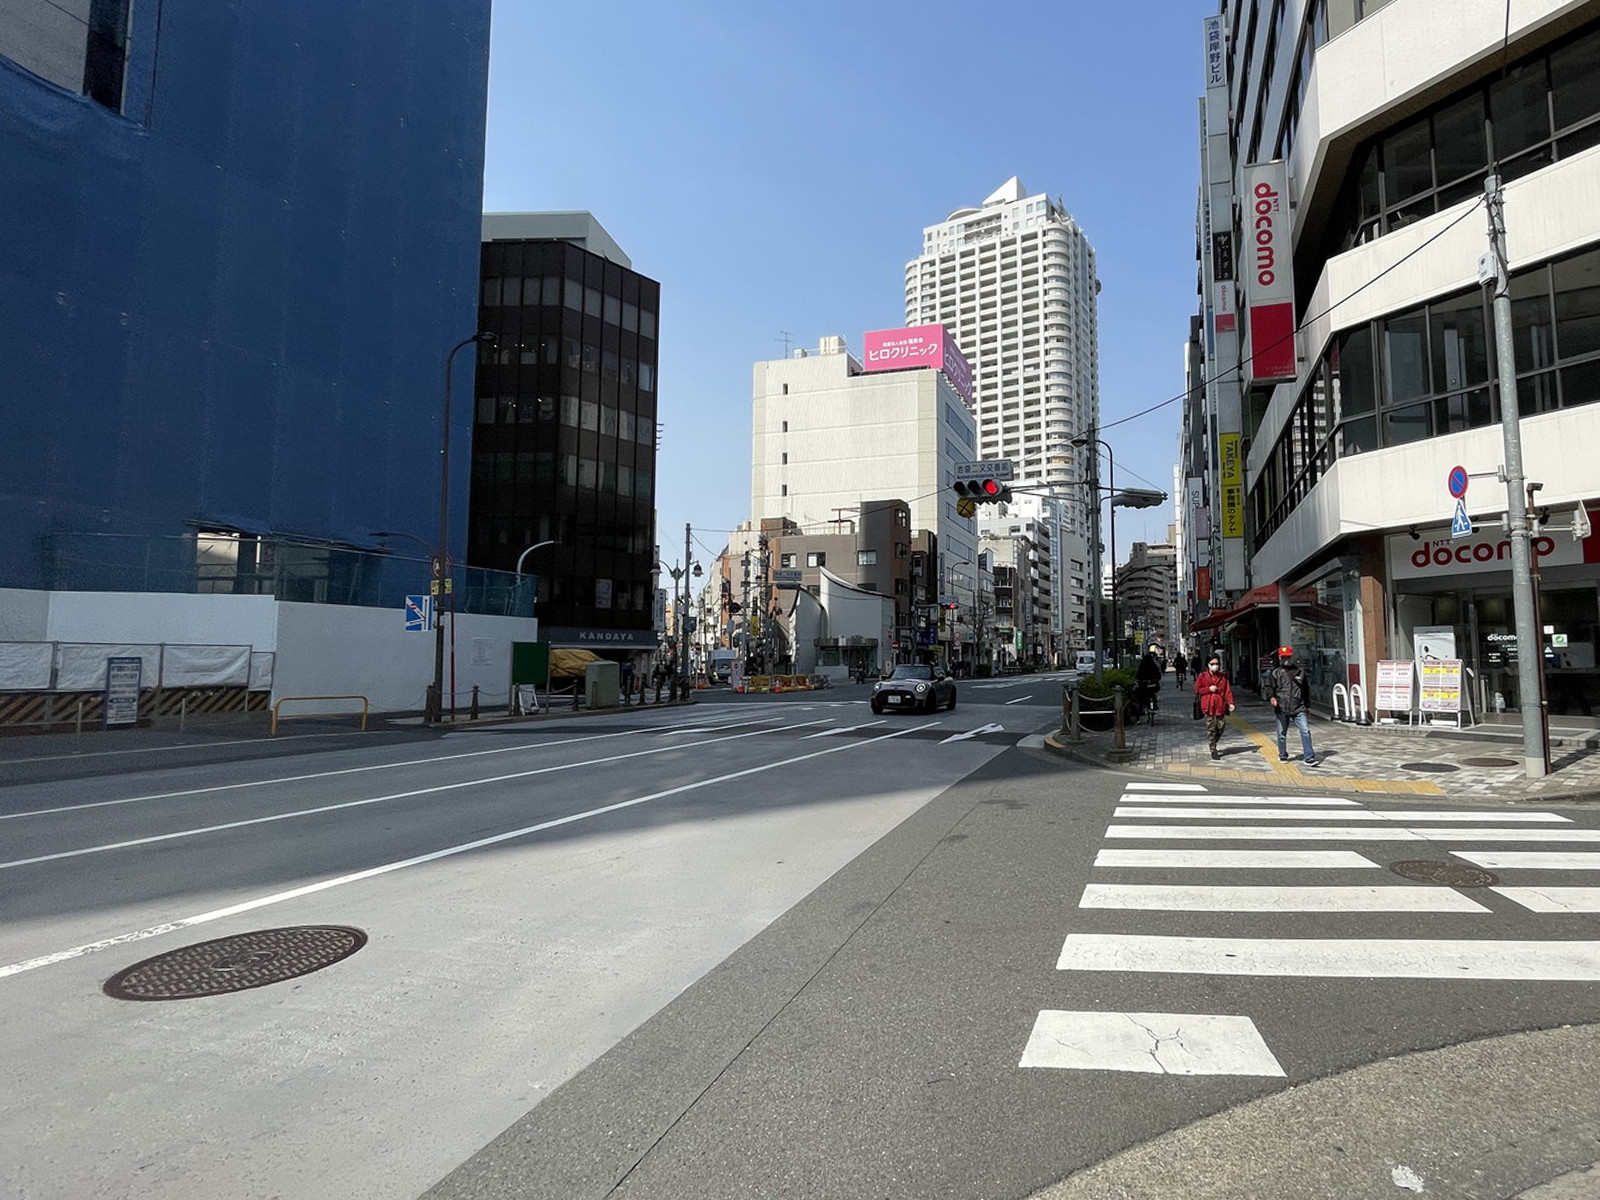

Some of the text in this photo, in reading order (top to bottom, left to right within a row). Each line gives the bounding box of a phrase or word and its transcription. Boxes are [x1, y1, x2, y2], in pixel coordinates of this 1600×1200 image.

[1209, 20, 1222, 84] 池袋岸野ビル
[1254, 182, 1278, 286] docomo
[869, 343, 938, 361] ヒロクリニック
[1226, 441, 1235, 479] TAKEYA
[1432, 539, 1451, 547] NTT
[579, 632, 634, 641] KANDAYA
